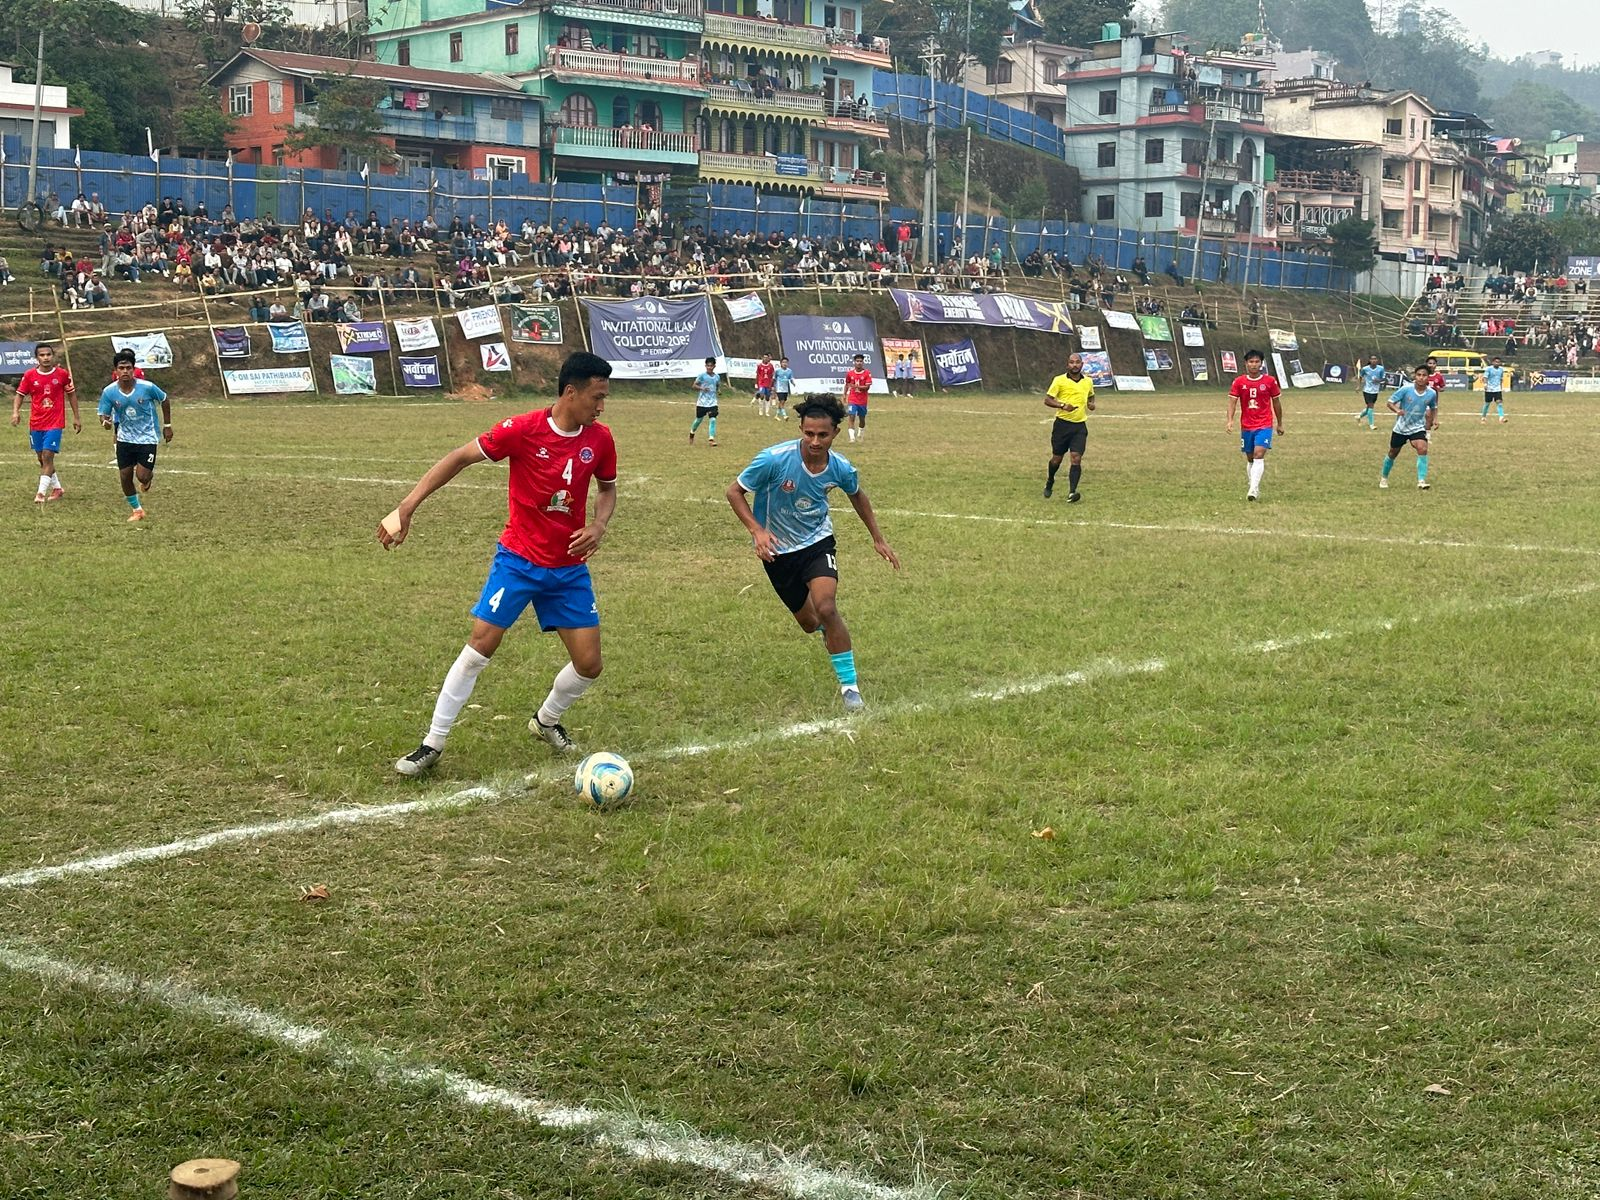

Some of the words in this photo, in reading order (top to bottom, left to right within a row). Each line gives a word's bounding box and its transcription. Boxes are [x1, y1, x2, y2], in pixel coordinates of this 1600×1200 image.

[1568, 266, 1592, 276] ZONE
[471, 308, 497, 321] FRIENDS
[601, 320, 673, 333] INVITATIONAL
[674, 320, 697, 333] ILAM
[796, 339, 858, 352] INVITATIONAL
[858, 340, 875, 353] ILAM
[238, 373, 249, 381] OM
[1249, 387, 1257, 398] 13
[561, 458, 573, 486] 4
[488, 587, 506, 613] 4
